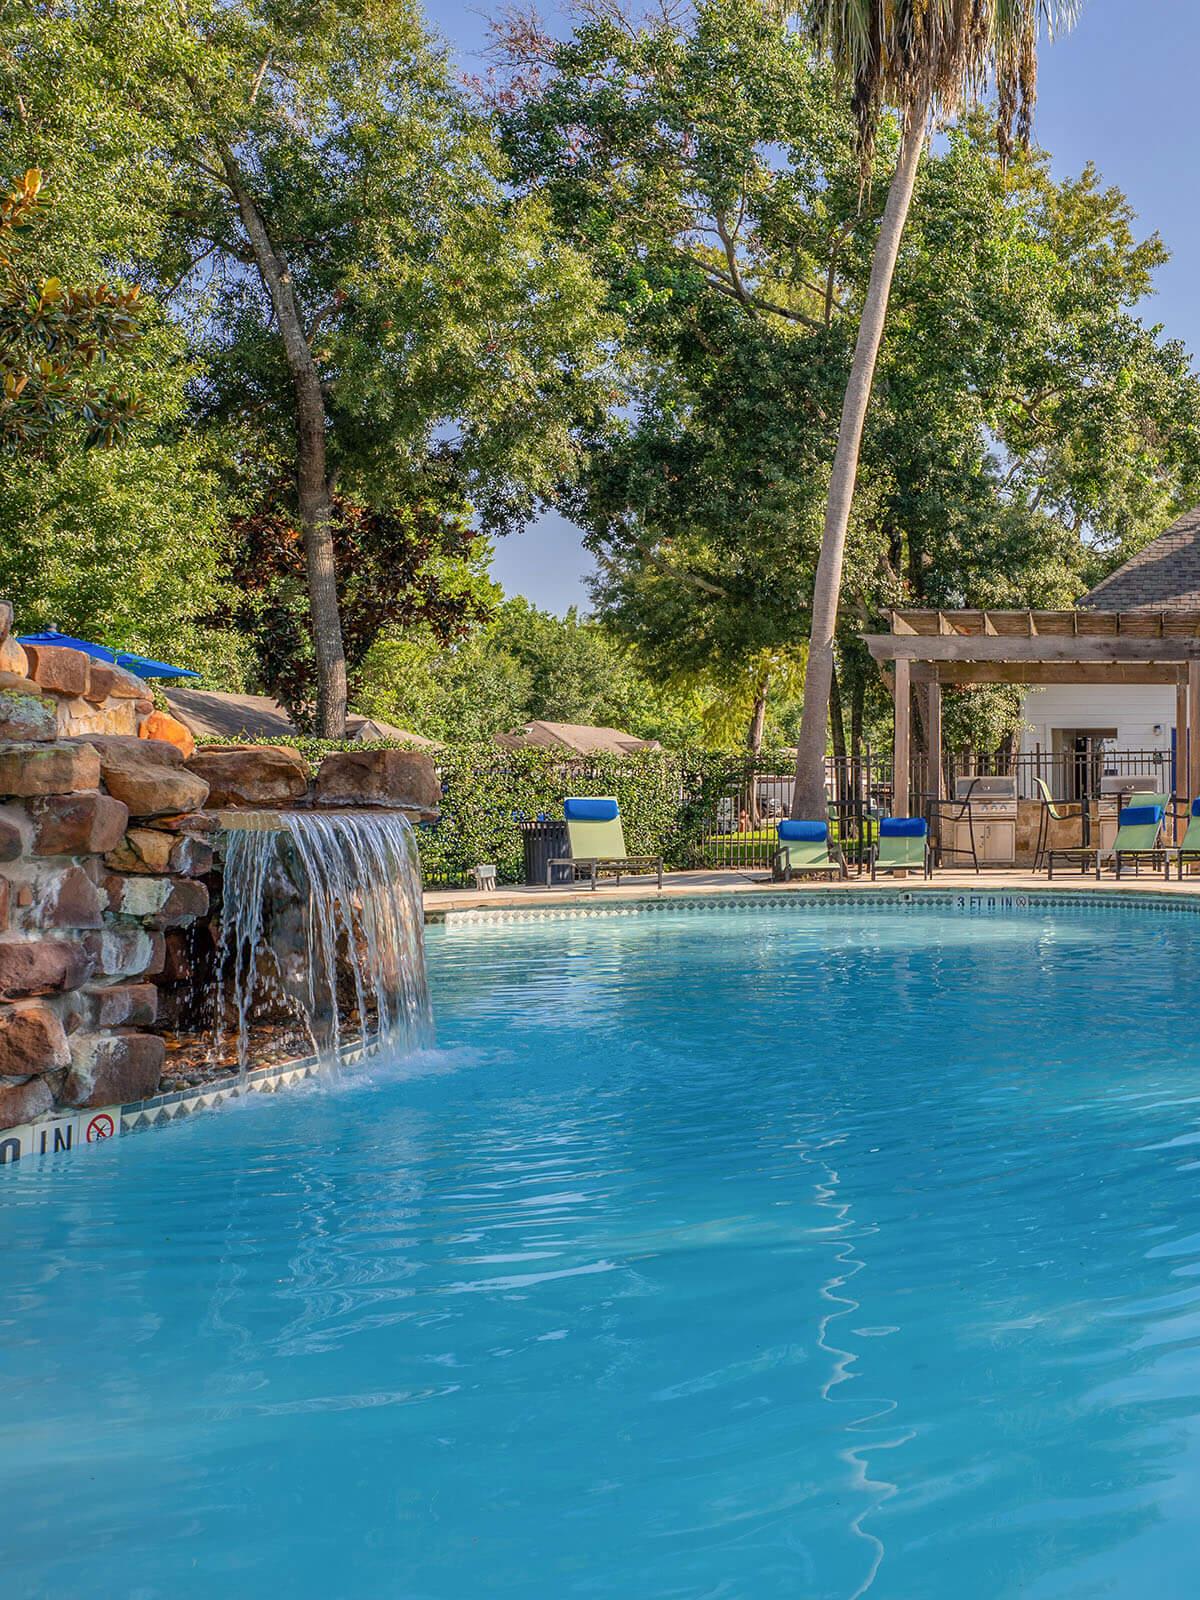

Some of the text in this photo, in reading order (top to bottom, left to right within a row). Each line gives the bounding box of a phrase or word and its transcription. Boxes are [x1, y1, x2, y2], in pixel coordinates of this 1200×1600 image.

[957, 896, 965, 906] 3
[970, 896, 983, 906] FT
[1001, 896, 1012, 906] IN
[40, 1125, 72, 1156] IN
